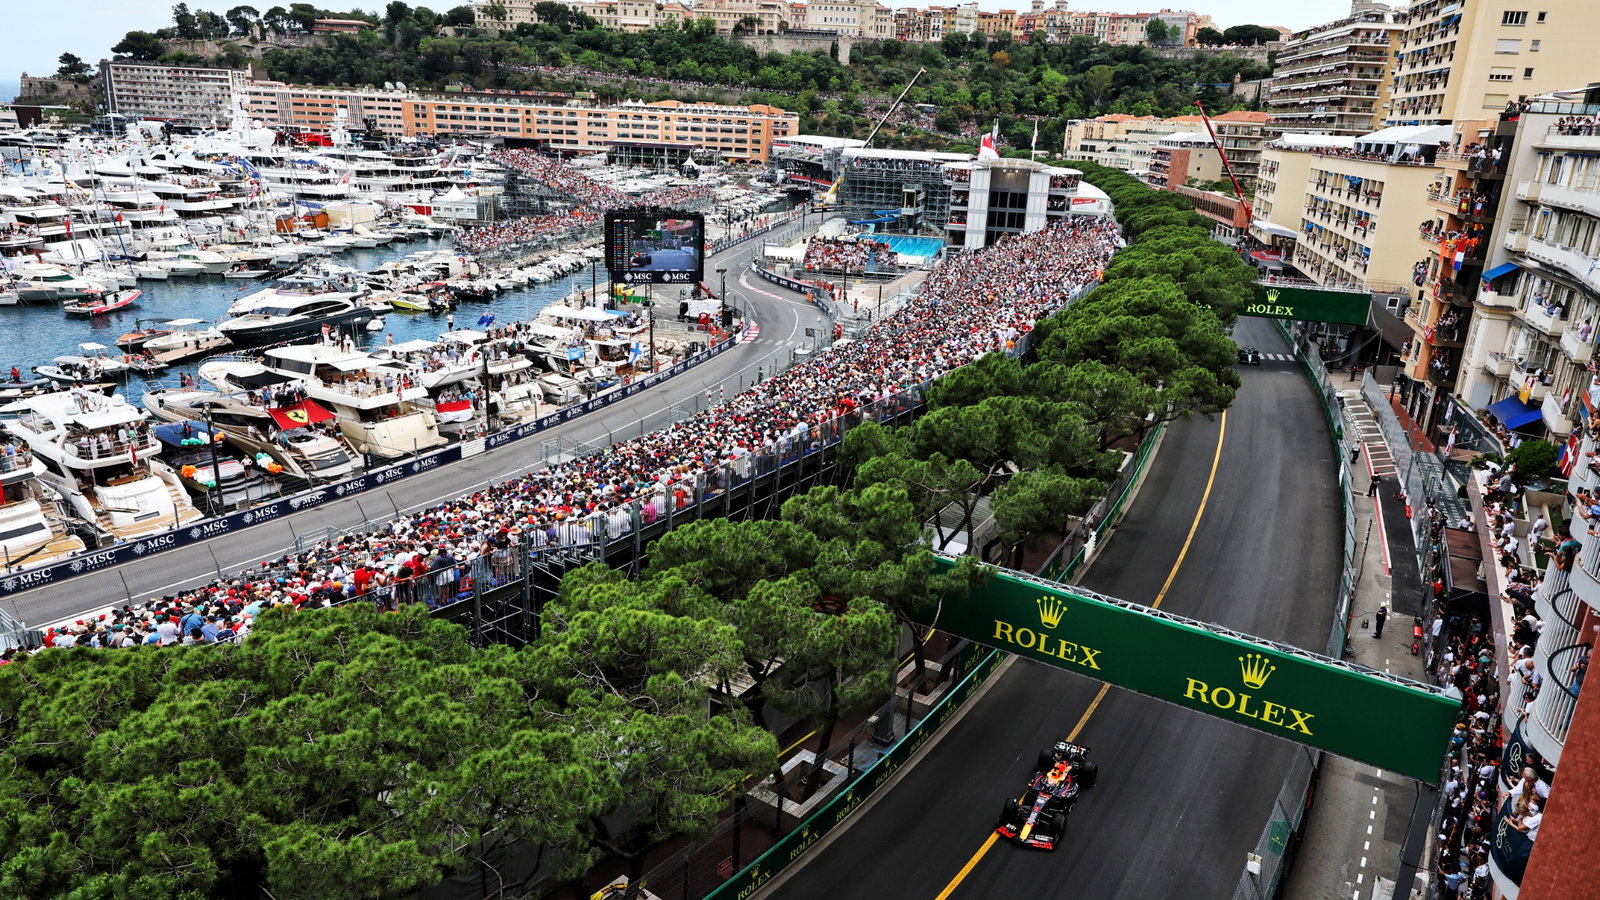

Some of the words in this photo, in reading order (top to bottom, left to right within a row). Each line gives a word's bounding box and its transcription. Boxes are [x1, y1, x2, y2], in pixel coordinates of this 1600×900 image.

[1246, 303, 1294, 316] ROLEX
[420, 456, 438, 468] MSC
[385, 467, 403, 479] MSC
[345, 479, 366, 491] MSC
[254, 505, 278, 519] MSC
[202, 519, 228, 534] MSC
[147, 534, 175, 550] MSC
[86, 550, 116, 566] MSC
[20, 567, 52, 585] MSC
[993, 619, 1102, 671] ROLEX
[1183, 677, 1315, 736] ROLEX
[836, 795, 861, 821] ROLEX
[790, 830, 820, 859] ROLEX
[737, 869, 772, 900] ROLEX
